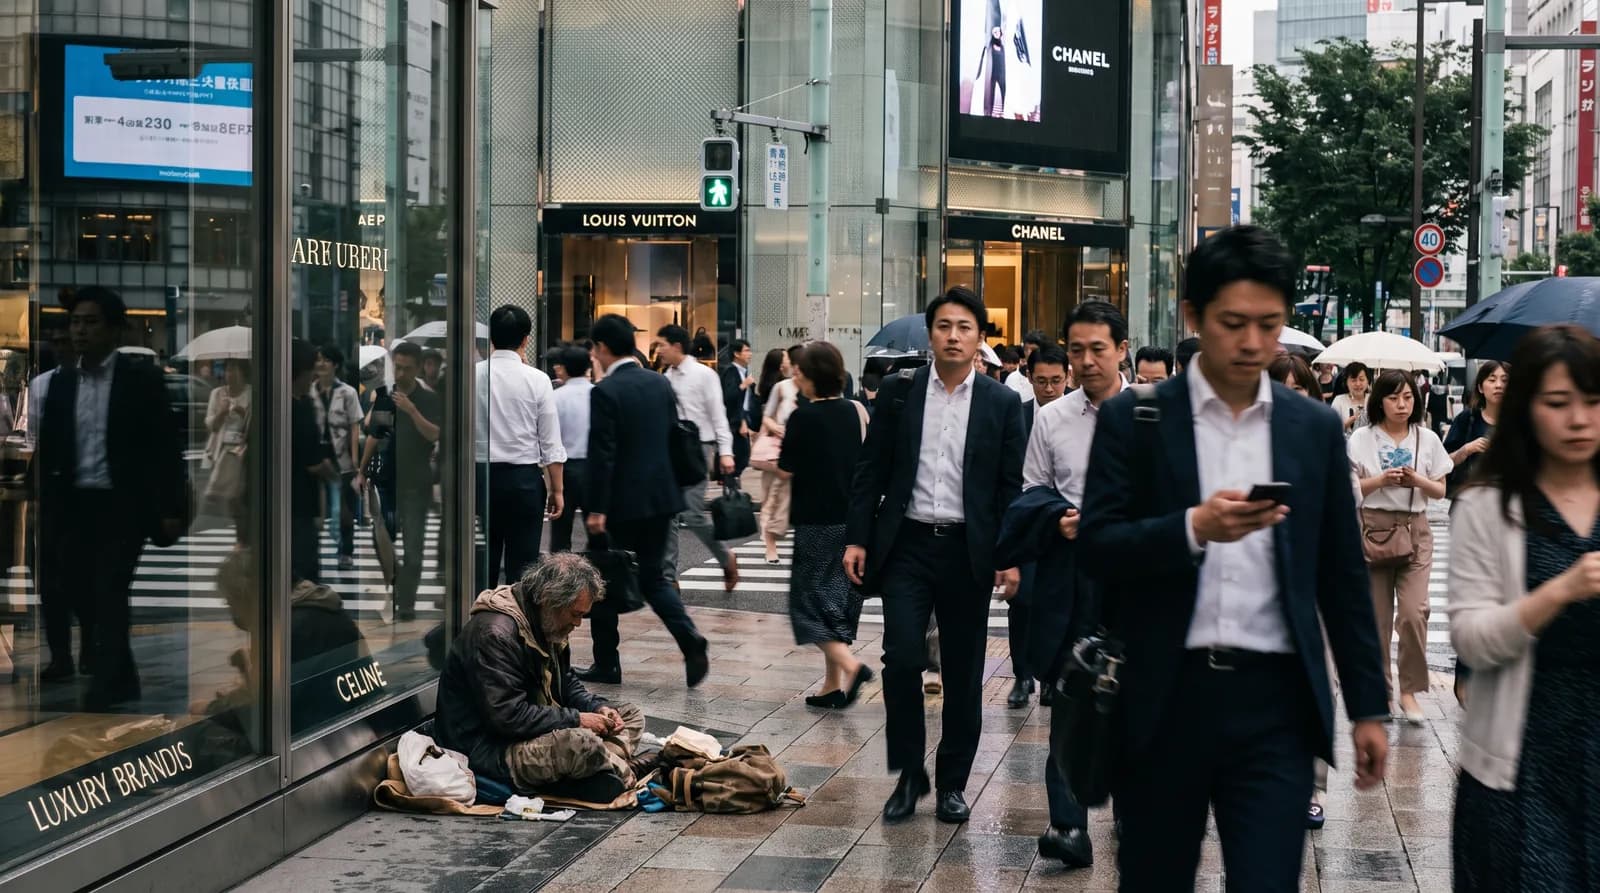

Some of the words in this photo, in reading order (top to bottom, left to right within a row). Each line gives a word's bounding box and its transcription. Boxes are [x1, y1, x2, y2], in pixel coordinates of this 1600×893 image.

[1052, 45, 1110, 68] CHANEL
[358, 214, 385, 226] AEP
[582, 214, 627, 227] LOUIS
[631, 214, 697, 227] VUITTON
[1011, 224, 1066, 241] CHANEL
[1421, 232, 1438, 247] 40
[336, 661, 388, 702] CELINE
[28, 772, 111, 832] LUXURY
[112, 741, 193, 797] BRANDIS
